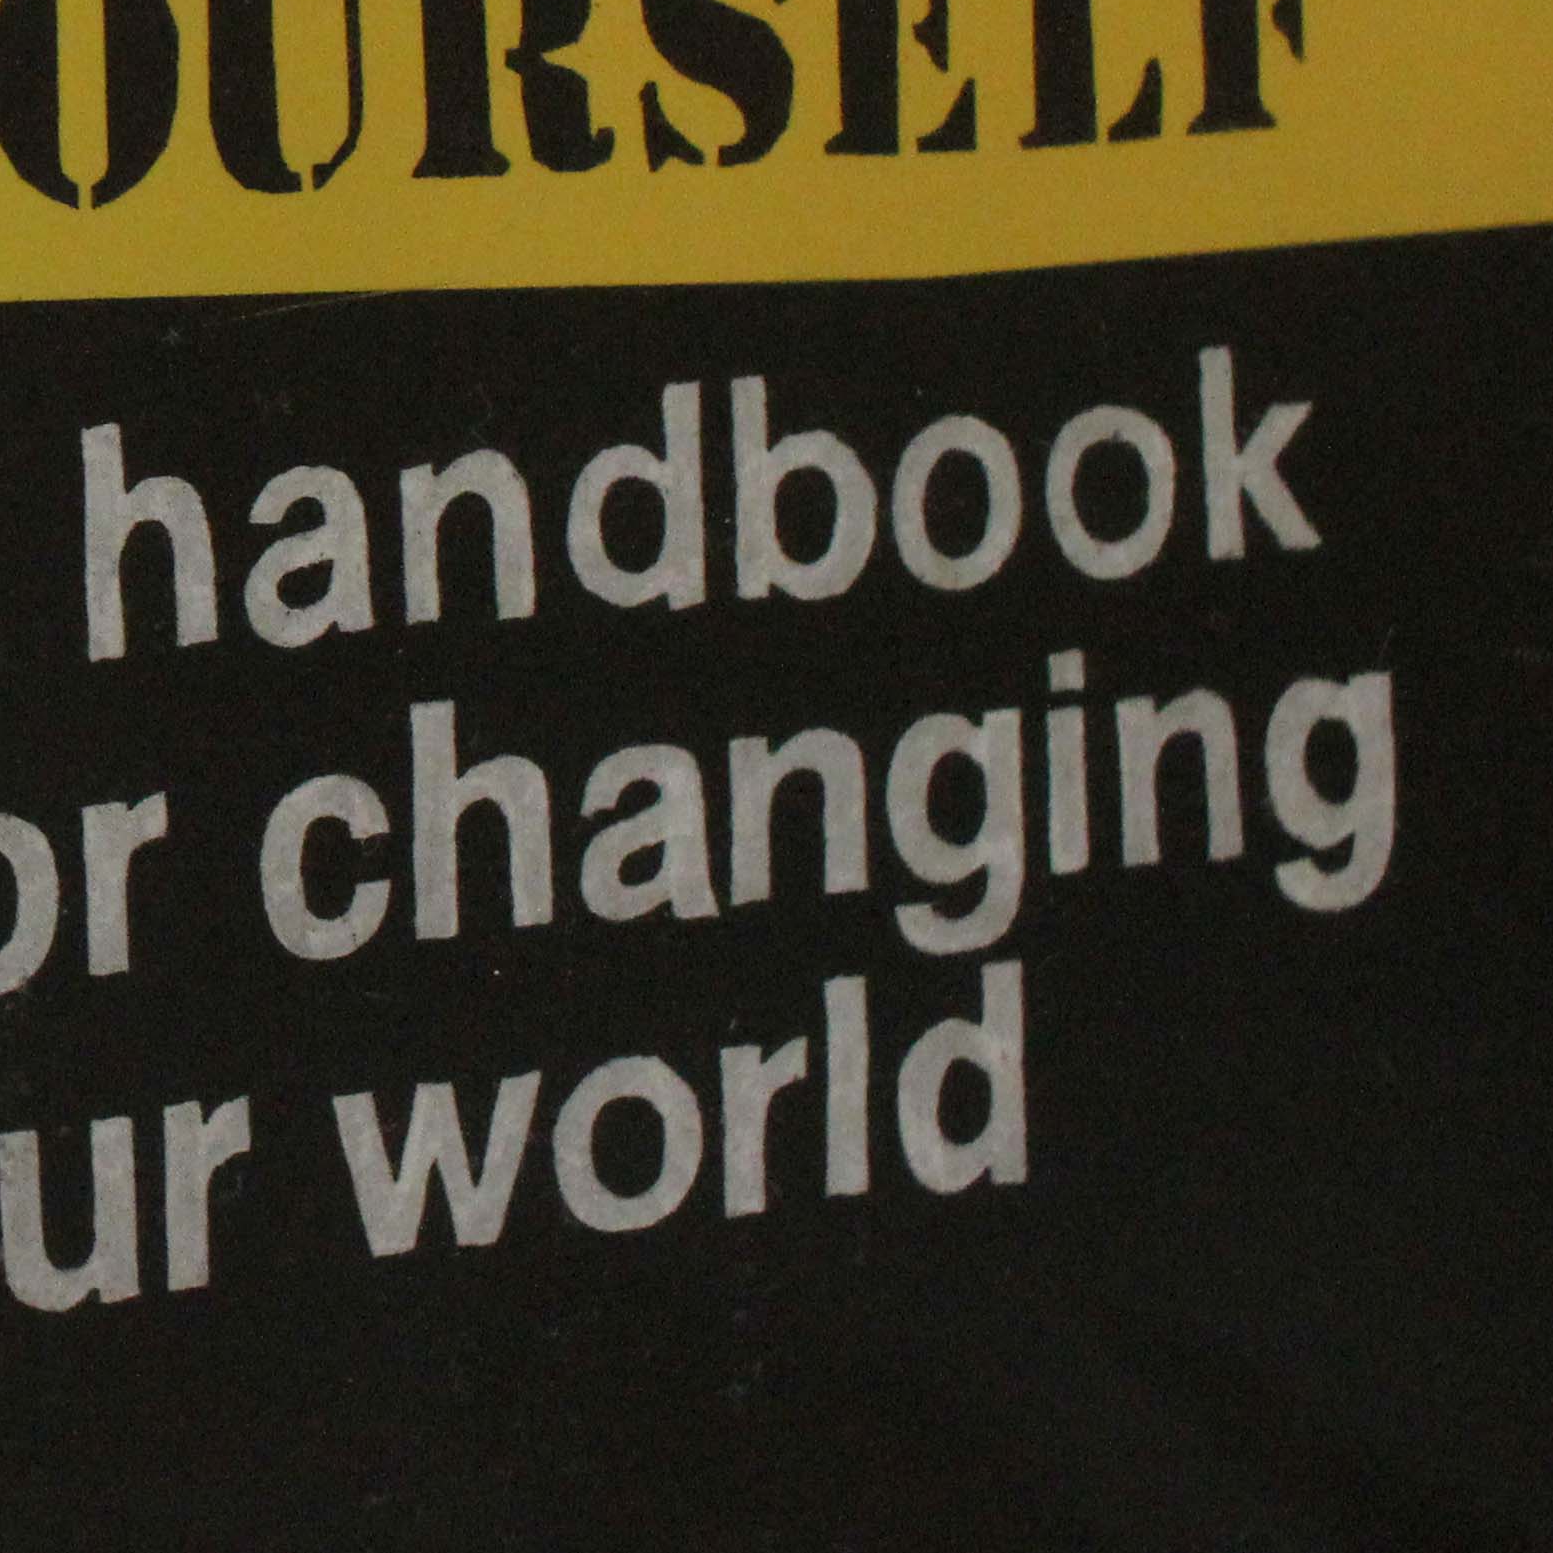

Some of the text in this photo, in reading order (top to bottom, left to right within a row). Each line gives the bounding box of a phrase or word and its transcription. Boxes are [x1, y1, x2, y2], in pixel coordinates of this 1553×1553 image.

[80, 343, 1321, 665] handbook
[259, 648, 1395, 961] changing
[332, 958, 1029, 1258] world
